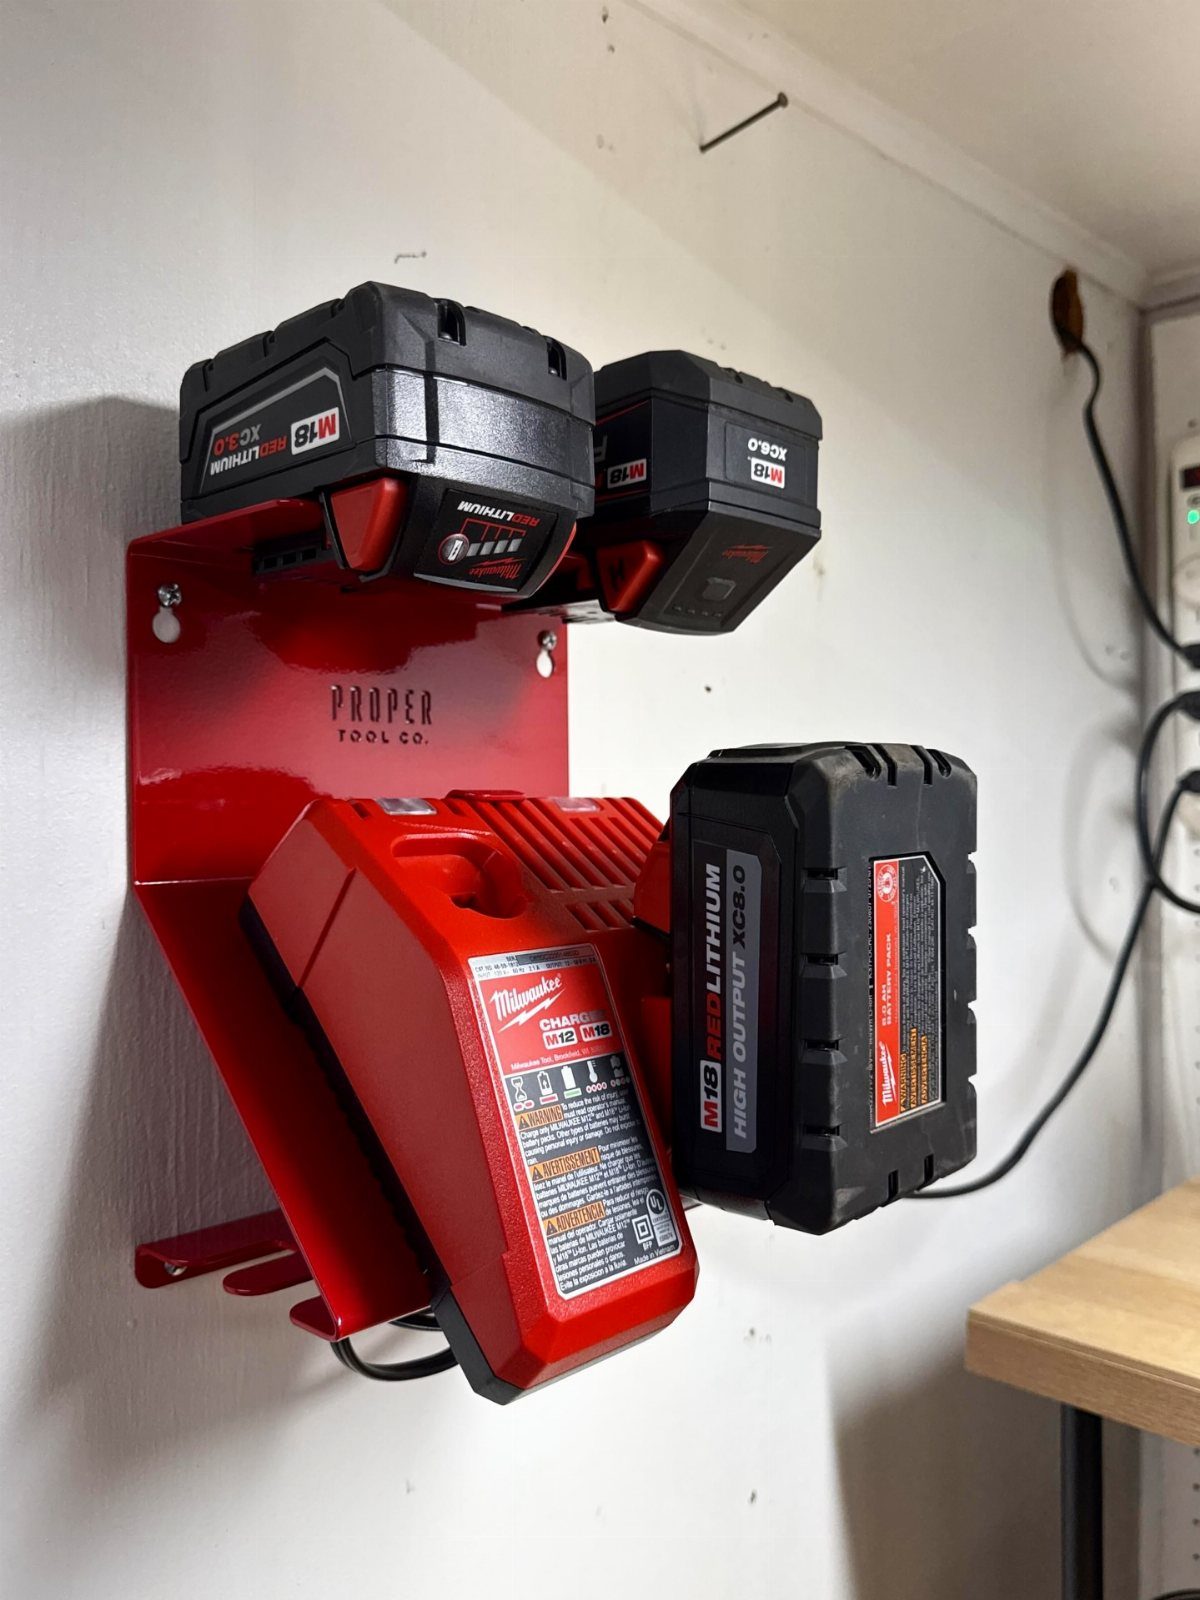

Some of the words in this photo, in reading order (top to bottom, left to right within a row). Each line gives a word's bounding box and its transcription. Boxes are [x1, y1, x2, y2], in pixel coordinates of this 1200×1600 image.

[213, 423, 262, 456] XC3.0
[294, 413, 337, 449] M18
[210, 435, 288, 476] REDLITHIUM
[748, 438, 787, 461] XC6.0
[610, 462, 645, 484] M18
[753, 463, 783, 484] M18
[457, 500, 541, 527] REDLITHIUM
[466, 563, 523, 580] Milwaukee
[330, 684, 432, 725] PROPER
[338, 729, 389, 744] TOOL
[399, 731, 429, 746] CO.
[732, 865, 746, 951] XC8.0
[705, 863, 721, 1060] REDLITHIUM
[490, 976, 562, 1020] Milwaukee
[732, 951, 747, 1063] OUTPUT
[539, 1010, 606, 1030] CHARG
[546, 1031, 575, 1044] M12
[583, 1024, 611, 1038] M18
[879, 1040, 894, 1107] Milwaukee
[703, 1064, 719, 1128] M18
[733, 1067, 747, 1139] HIGH
[527, 1107, 562, 1126] WARNING
[542, 1149, 599, 1177] AVERTISSEMENT
[556, 1203, 604, 1230] ADVERTENCIA
